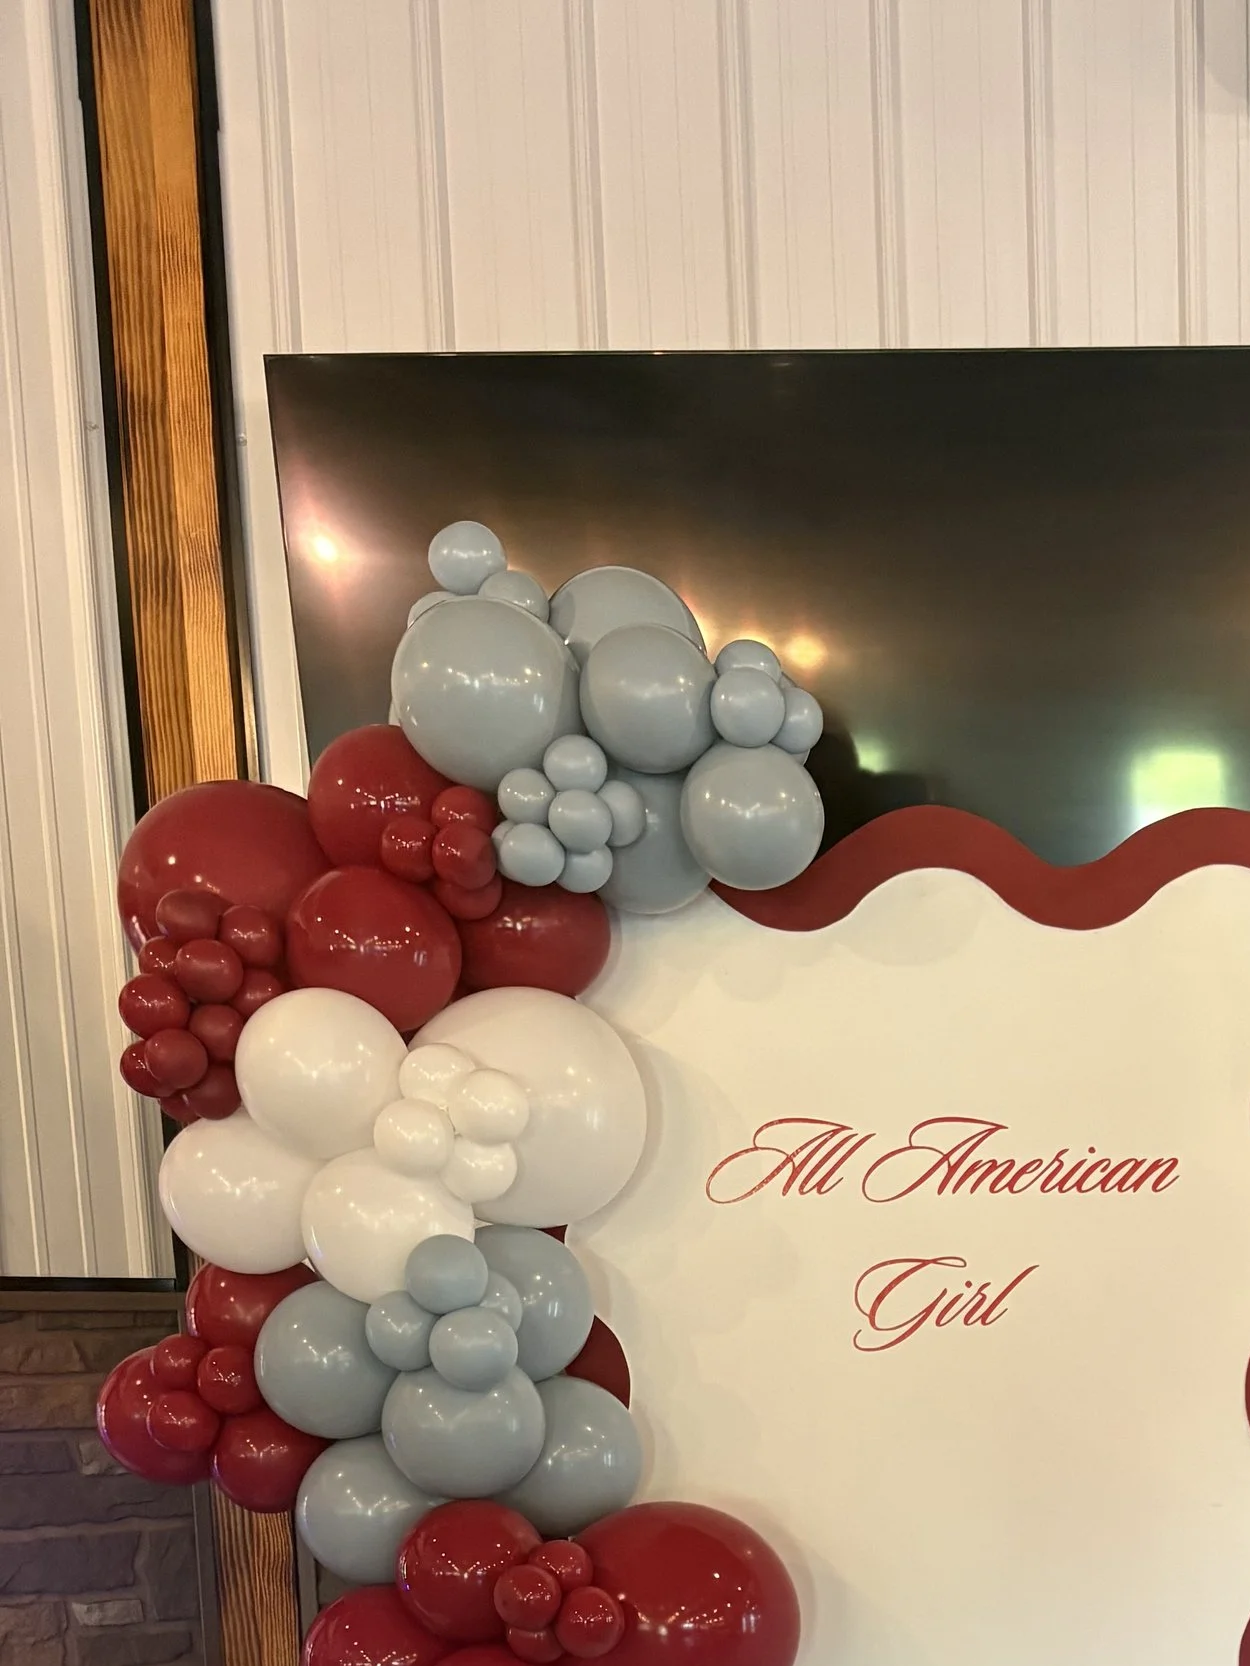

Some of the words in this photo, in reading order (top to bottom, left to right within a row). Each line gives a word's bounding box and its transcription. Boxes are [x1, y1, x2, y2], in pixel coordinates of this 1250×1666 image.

[706, 1117, 877, 1204] All
[861, 1116, 1180, 1203] American
[852, 1256, 1040, 1352] Girl
